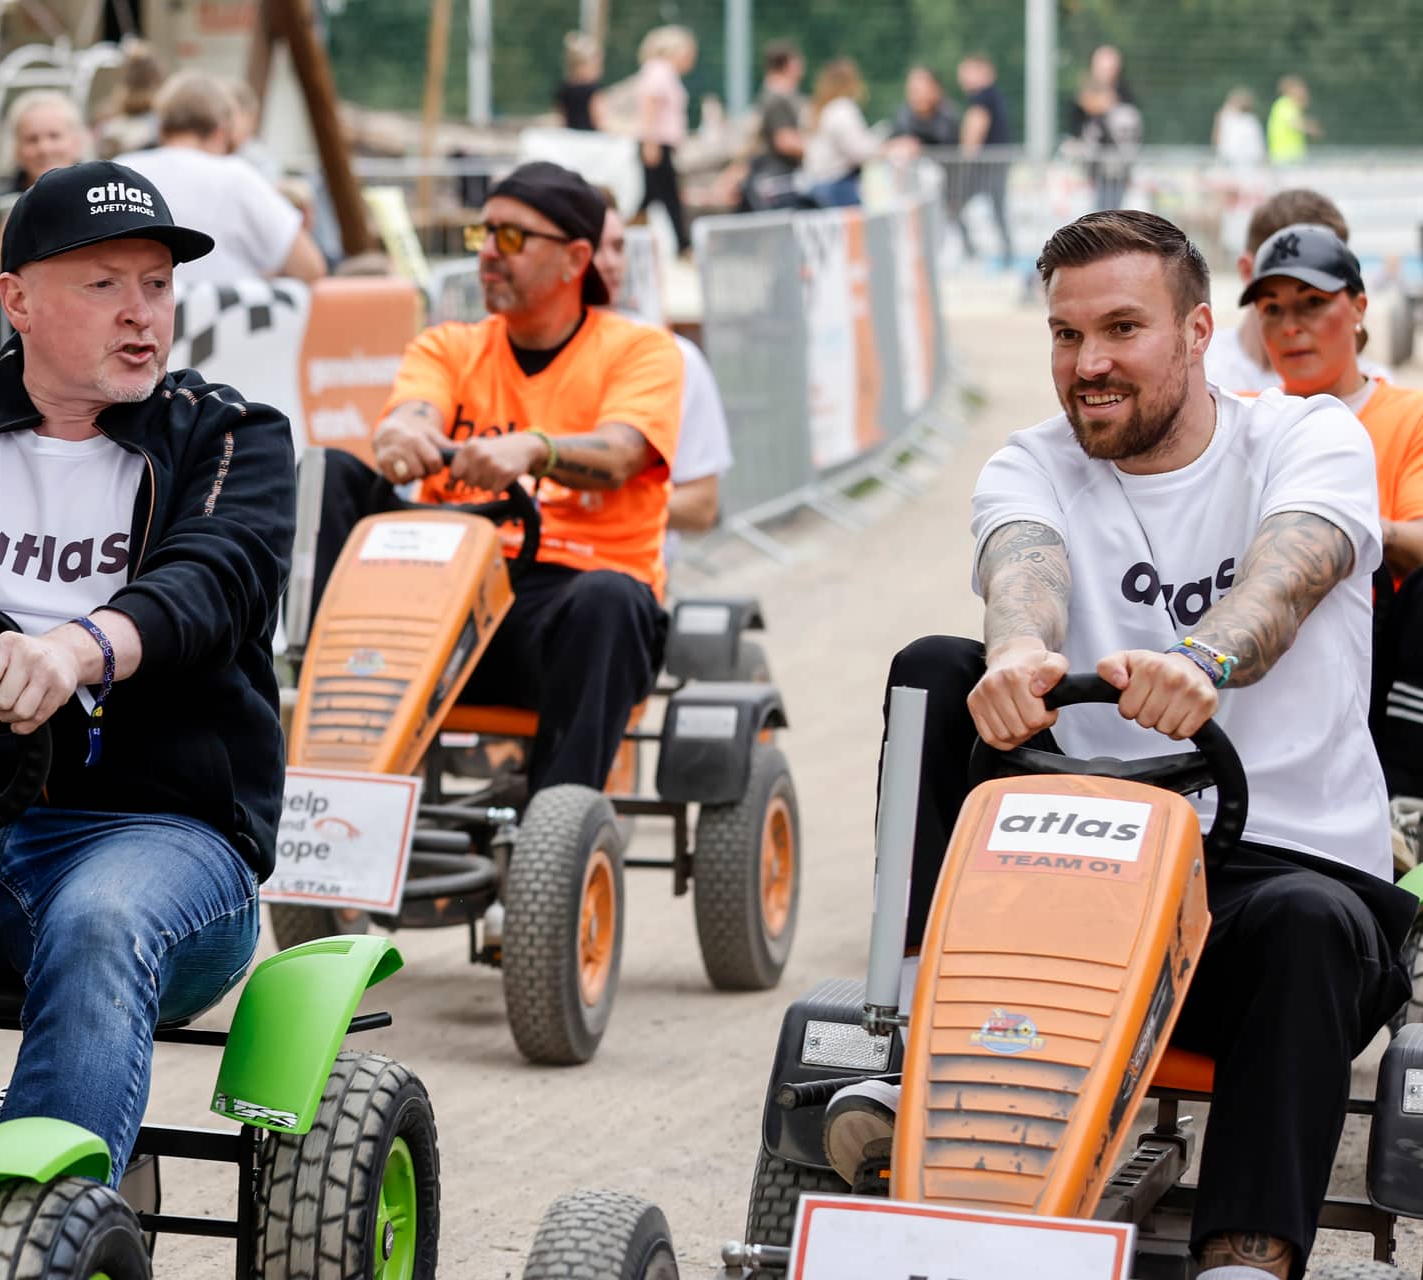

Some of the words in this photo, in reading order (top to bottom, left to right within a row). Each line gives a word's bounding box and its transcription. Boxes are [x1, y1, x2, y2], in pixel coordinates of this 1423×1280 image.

[86, 182, 153, 207] atlas
[90, 203, 127, 215] SAFETY
[128, 204, 155, 218] SHOES
[283, 789, 330, 818] elp
[999, 811, 1141, 841] atlas
[277, 839, 331, 863] ope
[996, 854, 1083, 870] TEAM
